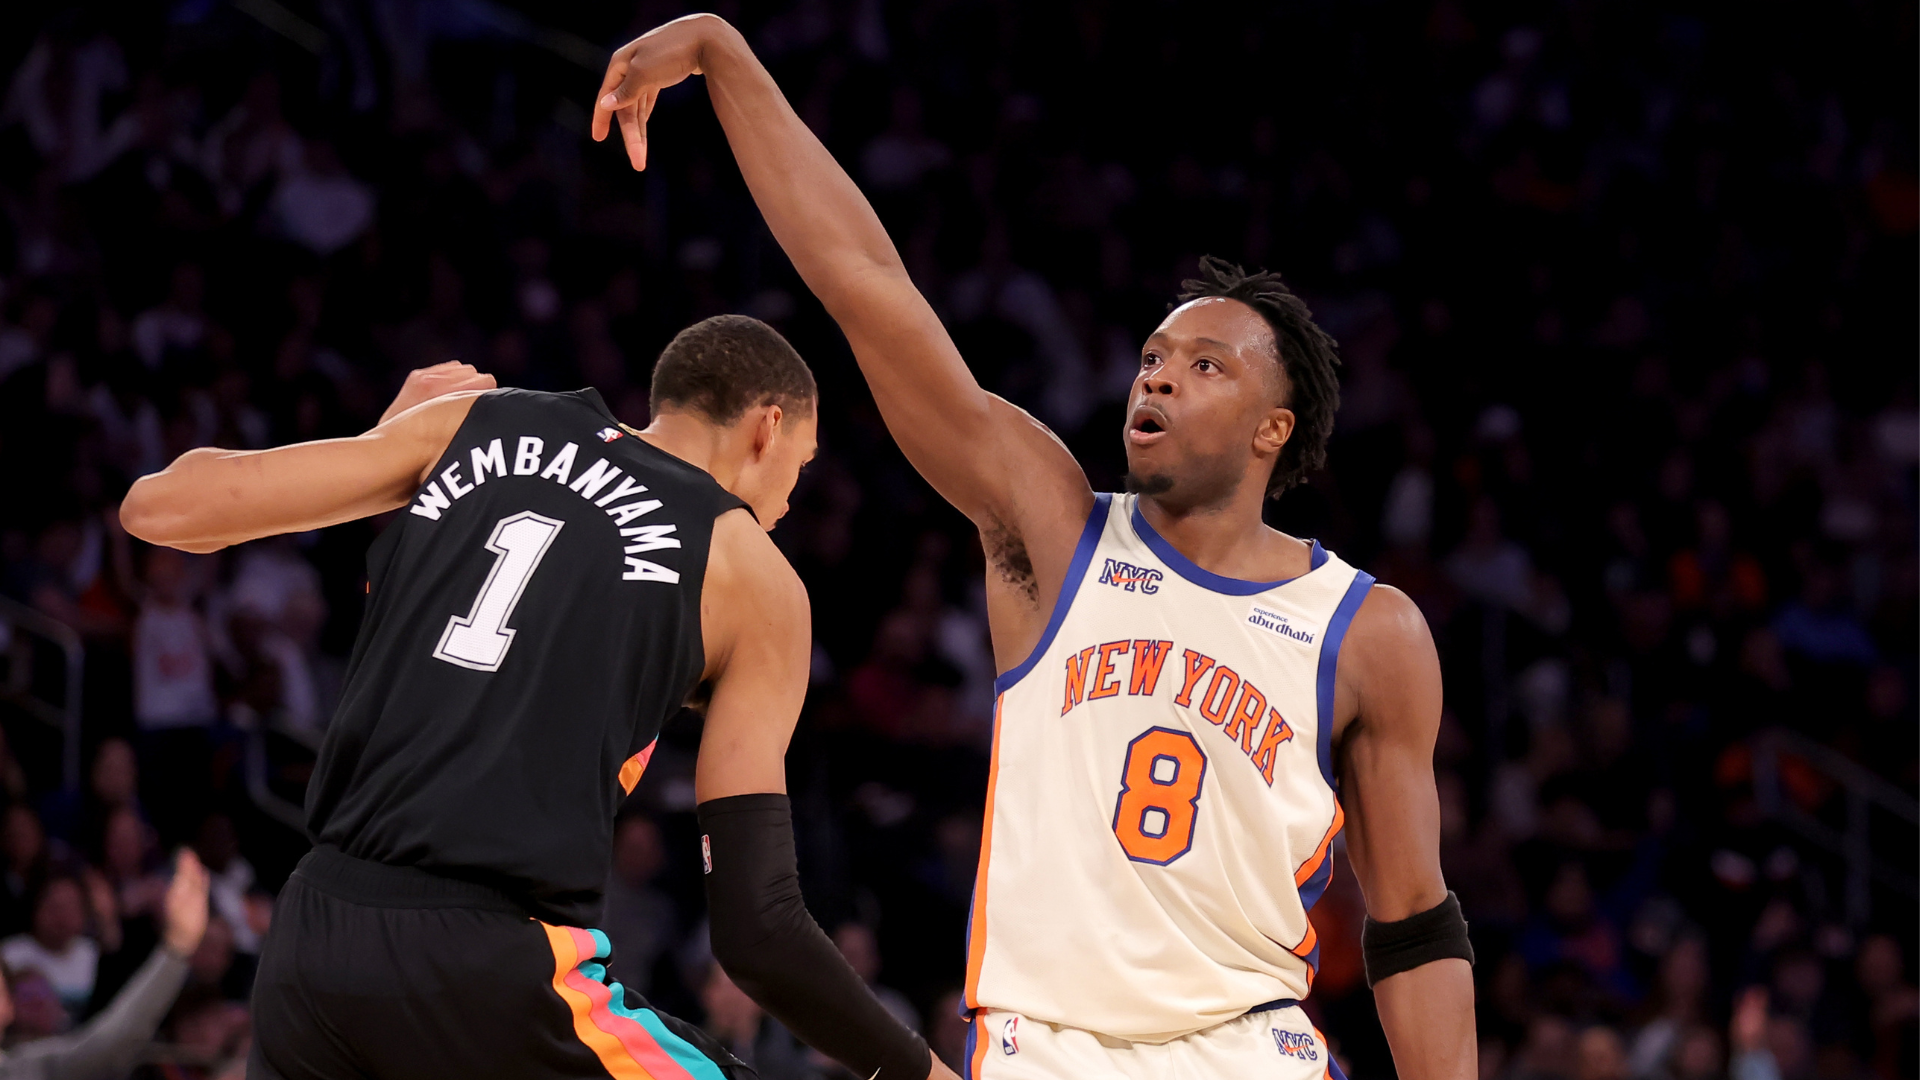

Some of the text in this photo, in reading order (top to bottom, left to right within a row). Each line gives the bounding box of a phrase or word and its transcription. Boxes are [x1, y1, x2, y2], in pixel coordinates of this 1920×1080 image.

[409, 435, 682, 584] WEMBANYAMA
[432, 510, 566, 672] 1
[1098, 558, 1164, 595] NYC
[1253, 607, 1288, 623] experience
[1248, 615, 1315, 645] abu dhabi
[1060, 639, 1294, 788] NEW YORK
[1112, 725, 1208, 867] 8
[1271, 1027, 1318, 1061] NYC
